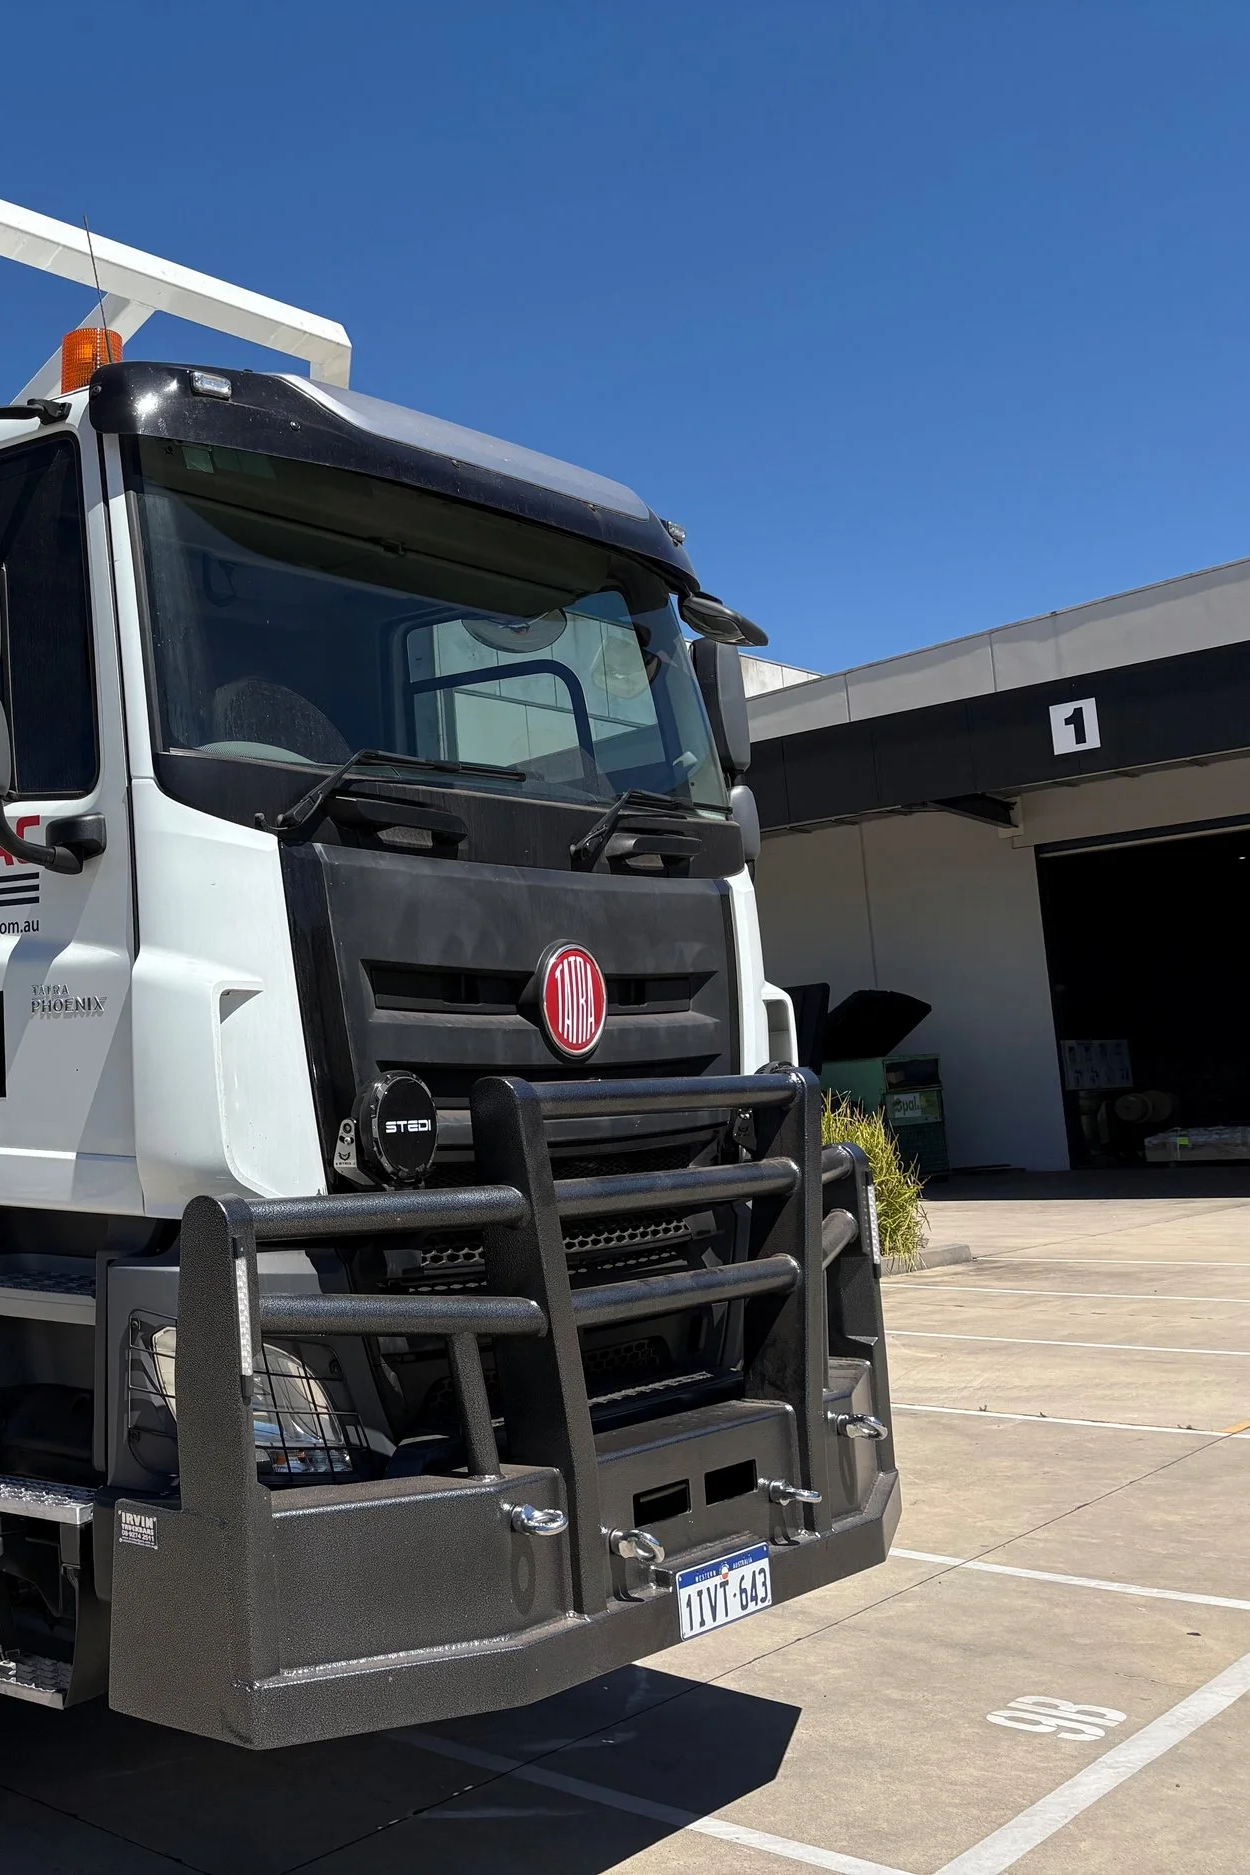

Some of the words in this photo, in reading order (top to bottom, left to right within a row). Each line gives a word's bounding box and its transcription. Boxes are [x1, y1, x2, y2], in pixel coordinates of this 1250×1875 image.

[1064, 706, 1087, 745] 1
[31, 985, 69, 996] TATRA
[31, 996, 106, 1014] PHOENIX
[556, 956, 595, 1044] TATRA
[385, 1119, 432, 1133] STEDI
[121, 1511, 155, 1529] IRVIN
